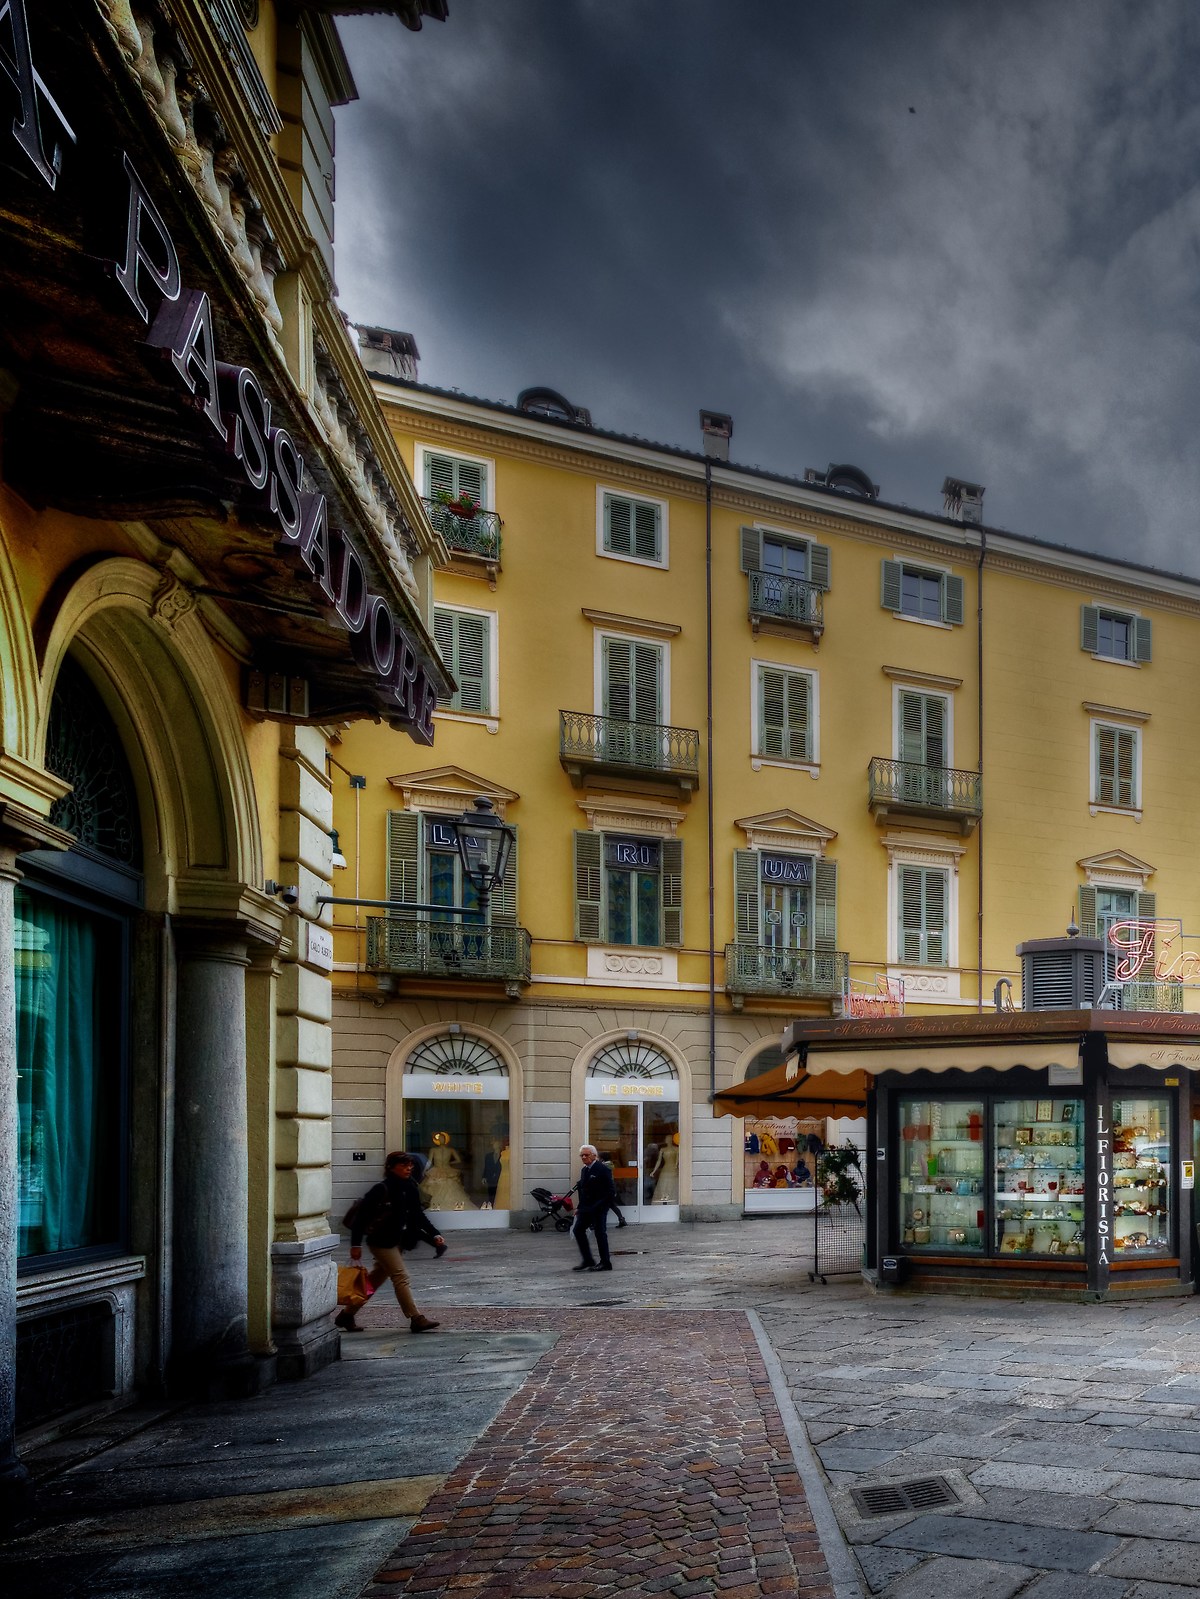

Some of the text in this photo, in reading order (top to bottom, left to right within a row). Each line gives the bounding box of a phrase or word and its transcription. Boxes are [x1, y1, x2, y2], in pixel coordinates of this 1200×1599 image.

[117, 151, 436, 746] PASSADORE
[617, 843, 650, 865] RI
[764, 858, 808, 880] UM
[1140, 1017, 1158, 1029] Il
[432, 1081, 484, 1095] WHITE
[602, 1084, 664, 1097] LE SPOSE
[1097, 1104, 1110, 1265] IL FIORISTA
